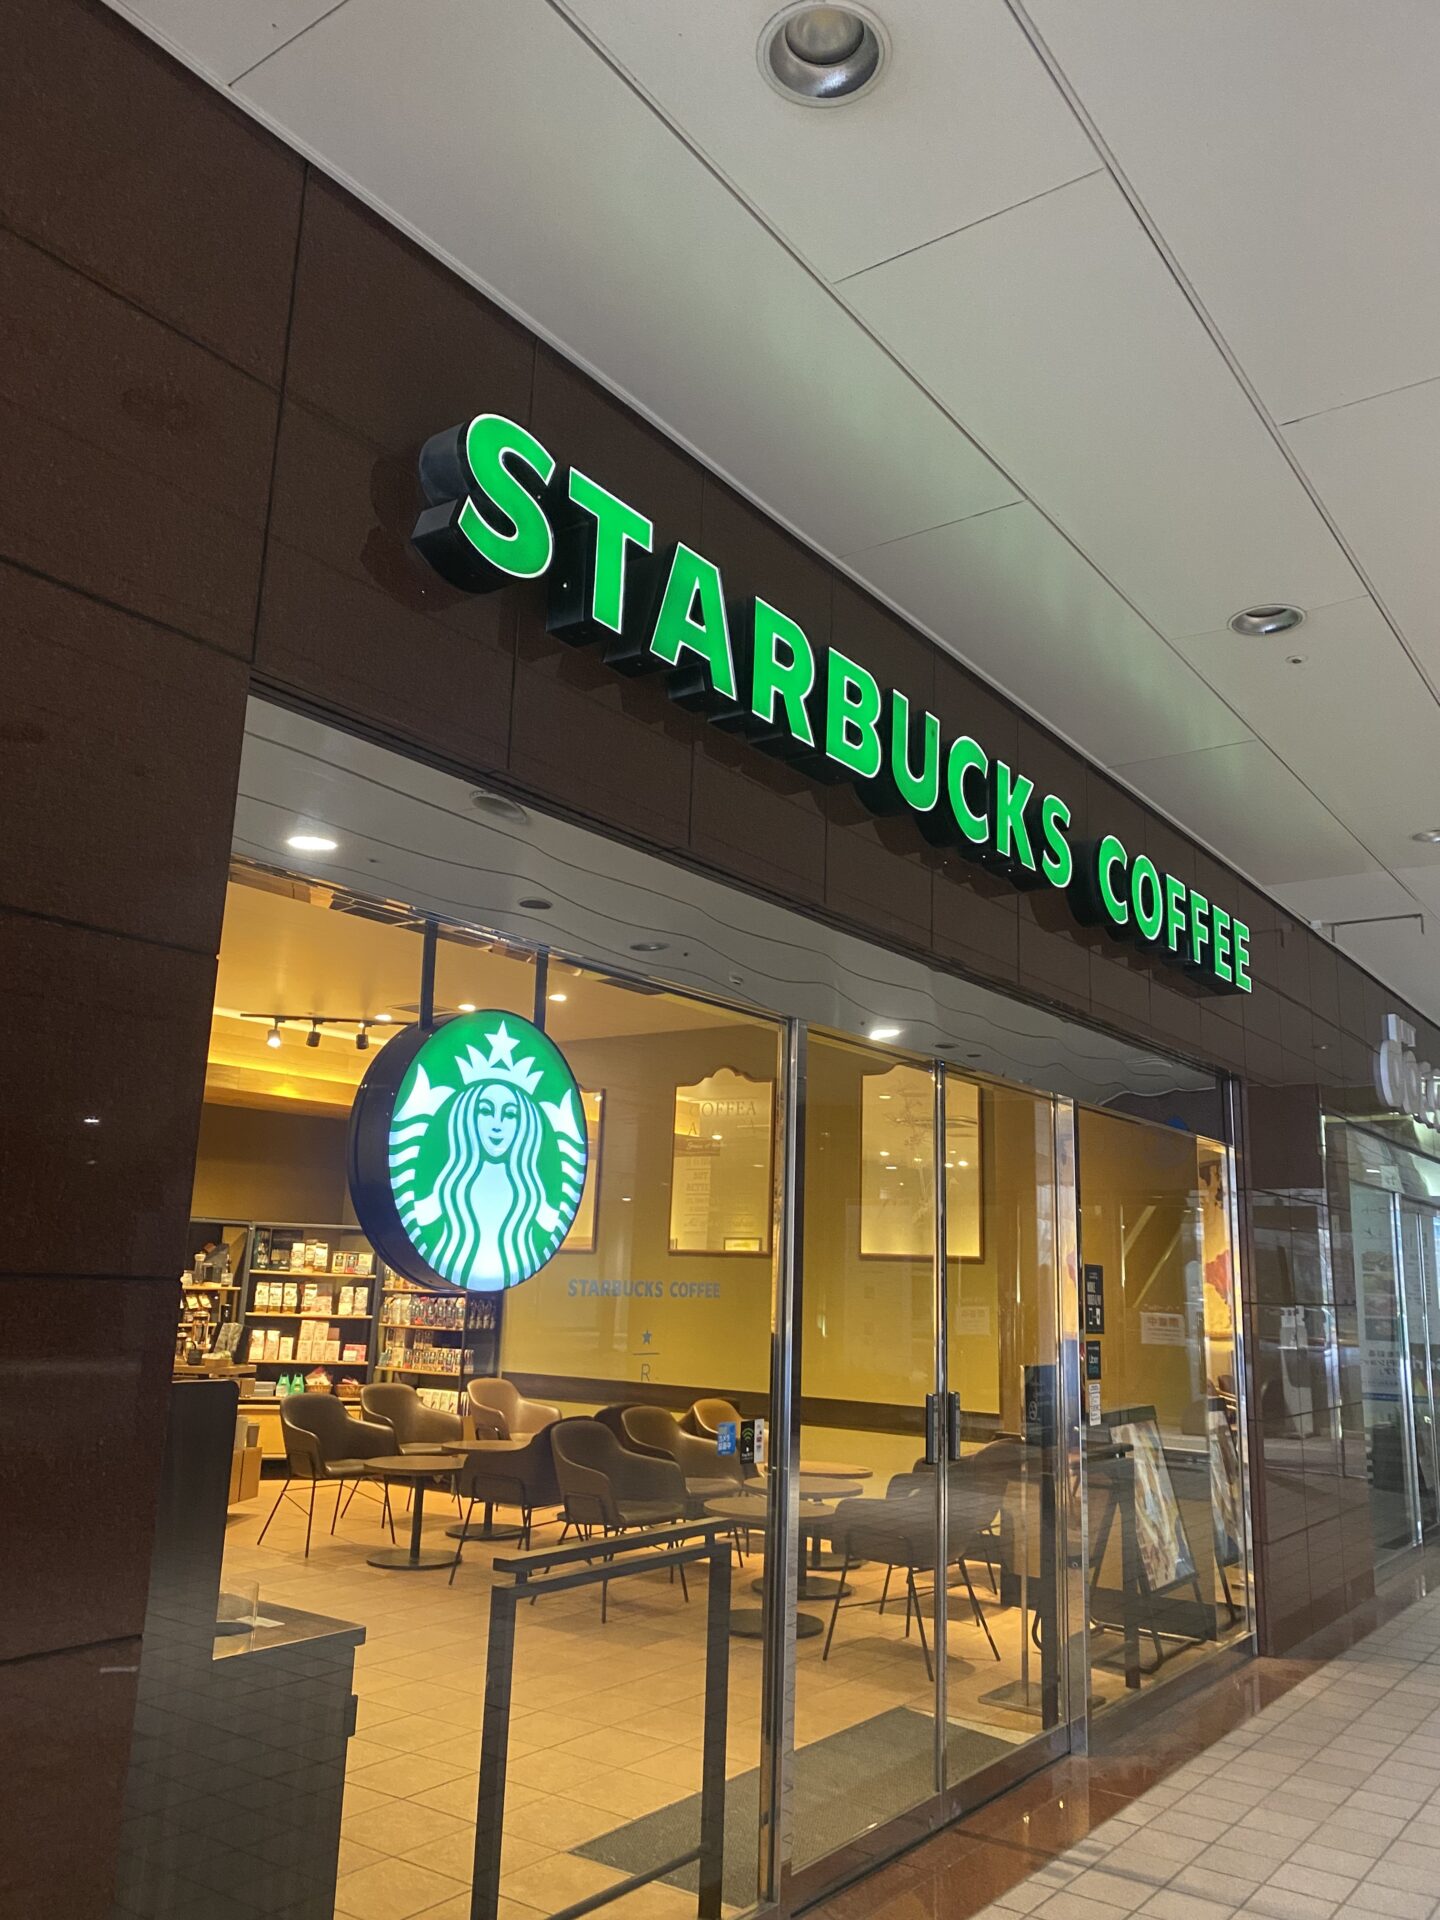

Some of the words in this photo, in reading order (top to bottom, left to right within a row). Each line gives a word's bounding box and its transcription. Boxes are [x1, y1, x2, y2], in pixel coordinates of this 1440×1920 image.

[457, 413, 1073, 889] STARBUCKS
[1097, 835, 1252, 992] COFFEE
[568, 1279, 664, 1297] STARBUCKS
[669, 1281, 721, 1298] COFFEE
[640, 1363, 651, 1382] R
